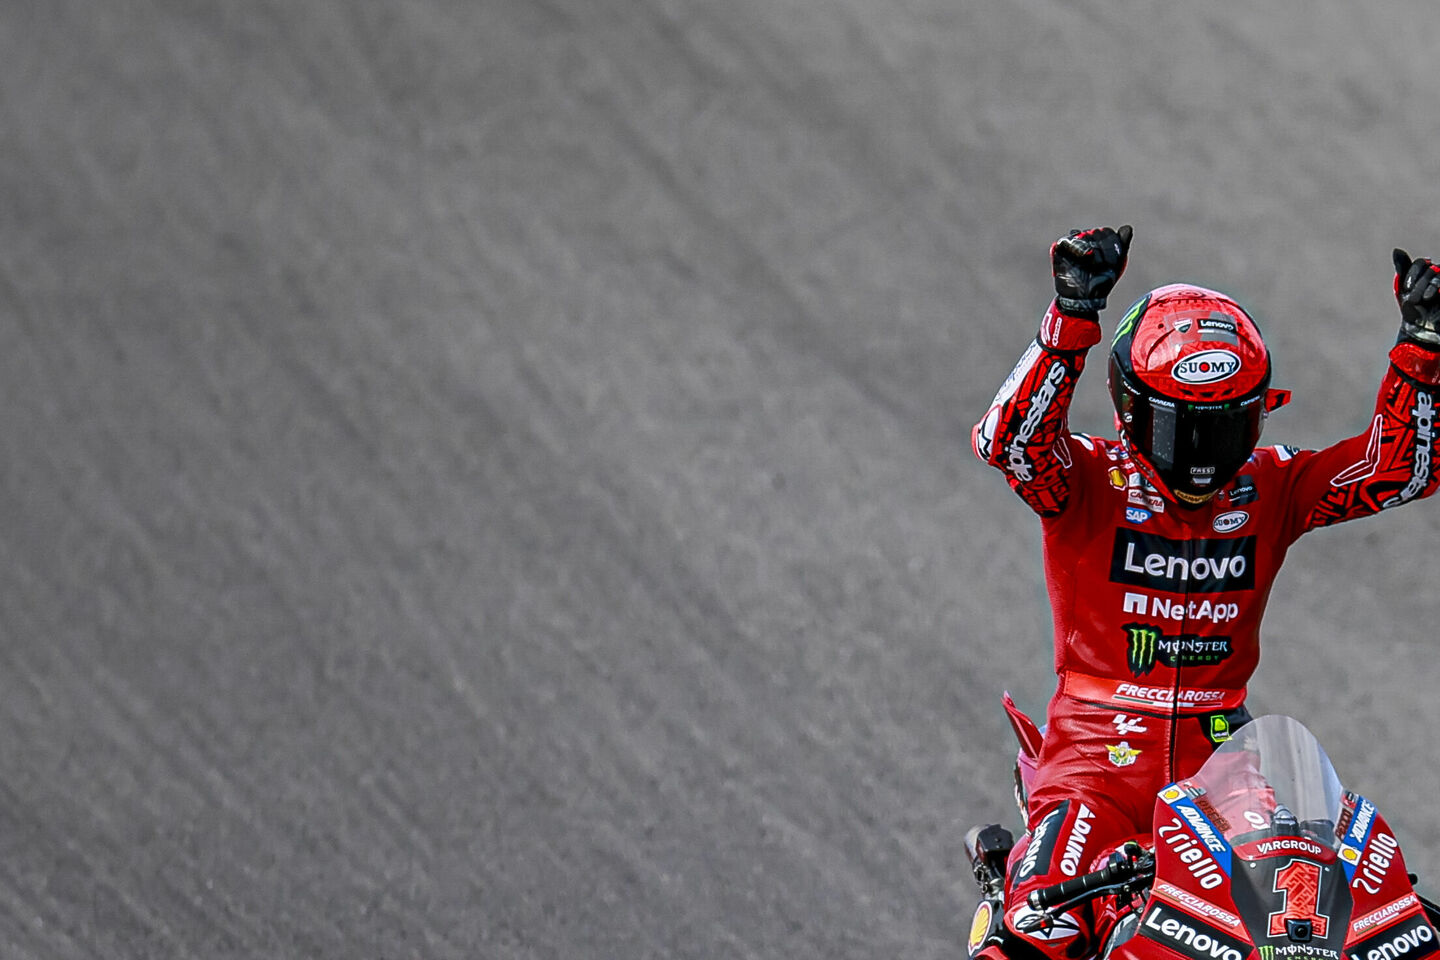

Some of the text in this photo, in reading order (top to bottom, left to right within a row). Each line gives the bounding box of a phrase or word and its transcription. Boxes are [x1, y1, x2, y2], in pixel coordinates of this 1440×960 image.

[1200, 319, 1234, 331] Lenovo
[1180, 362, 1235, 374] SUOMY
[1005, 361, 1066, 482] alpinestars
[1126, 509, 1148, 523] SAP
[1124, 542, 1246, 581] Lenovo
[1151, 597, 1239, 624] NetApp
[1157, 883, 1241, 928] FRECCIAROSSA
[1267, 858, 1330, 940] 1
[1352, 894, 1419, 933] FRECCIAROSSA
